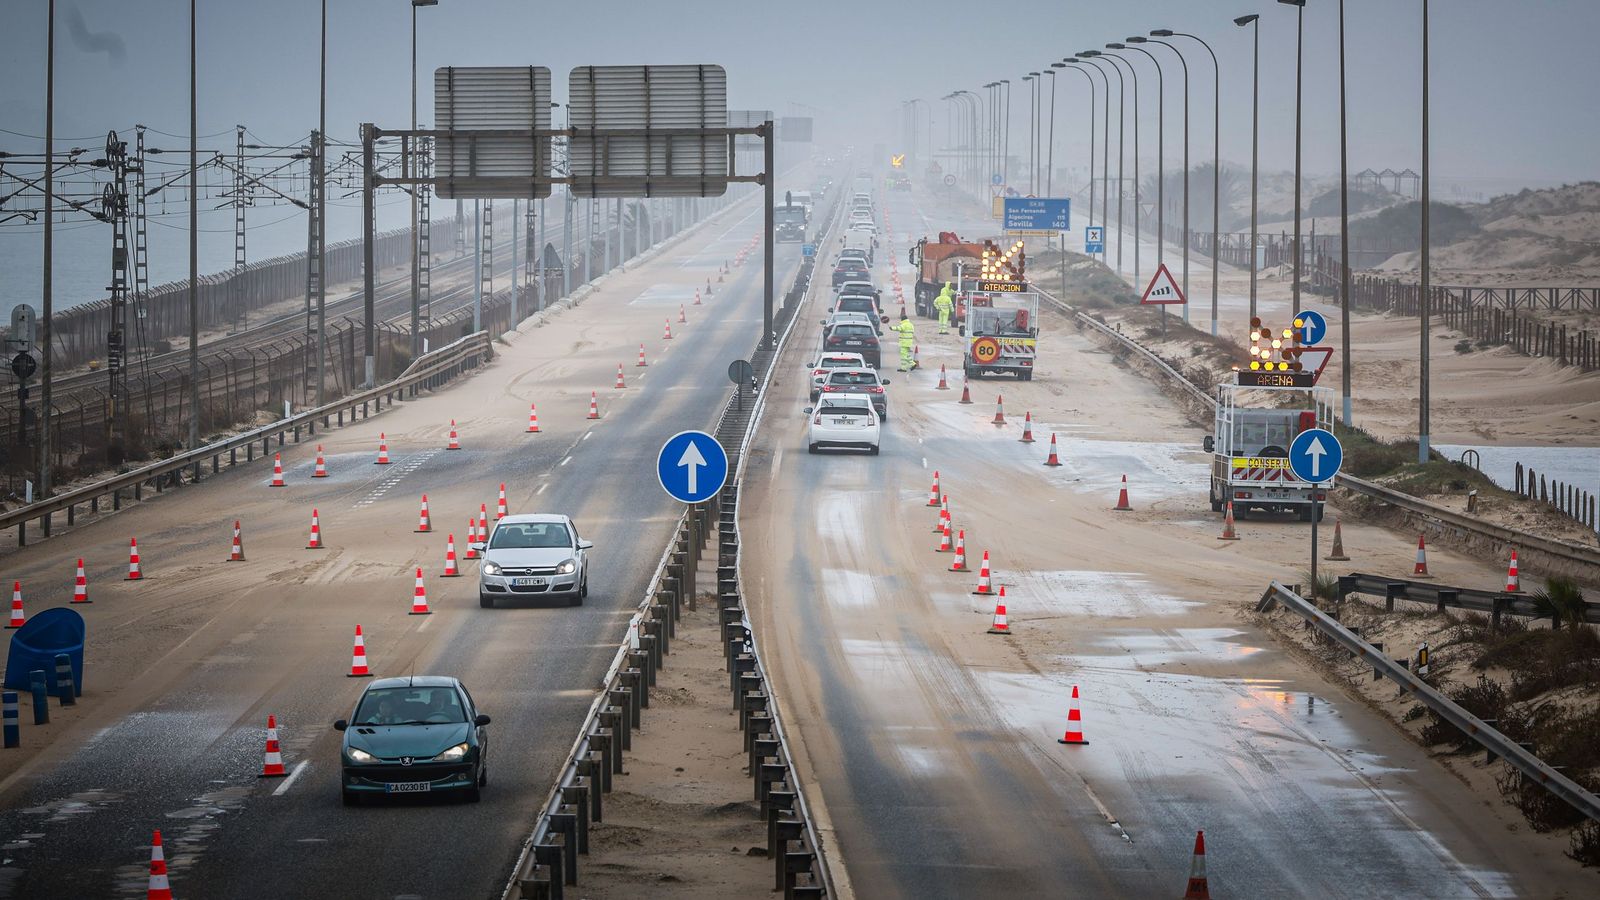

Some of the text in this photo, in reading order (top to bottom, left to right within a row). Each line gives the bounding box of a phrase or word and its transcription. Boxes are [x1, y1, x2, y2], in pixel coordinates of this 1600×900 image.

[979, 345, 994, 356] 80
[1257, 374, 1293, 386] ARENA
[390, 783, 429, 792] CA 0230 BT
